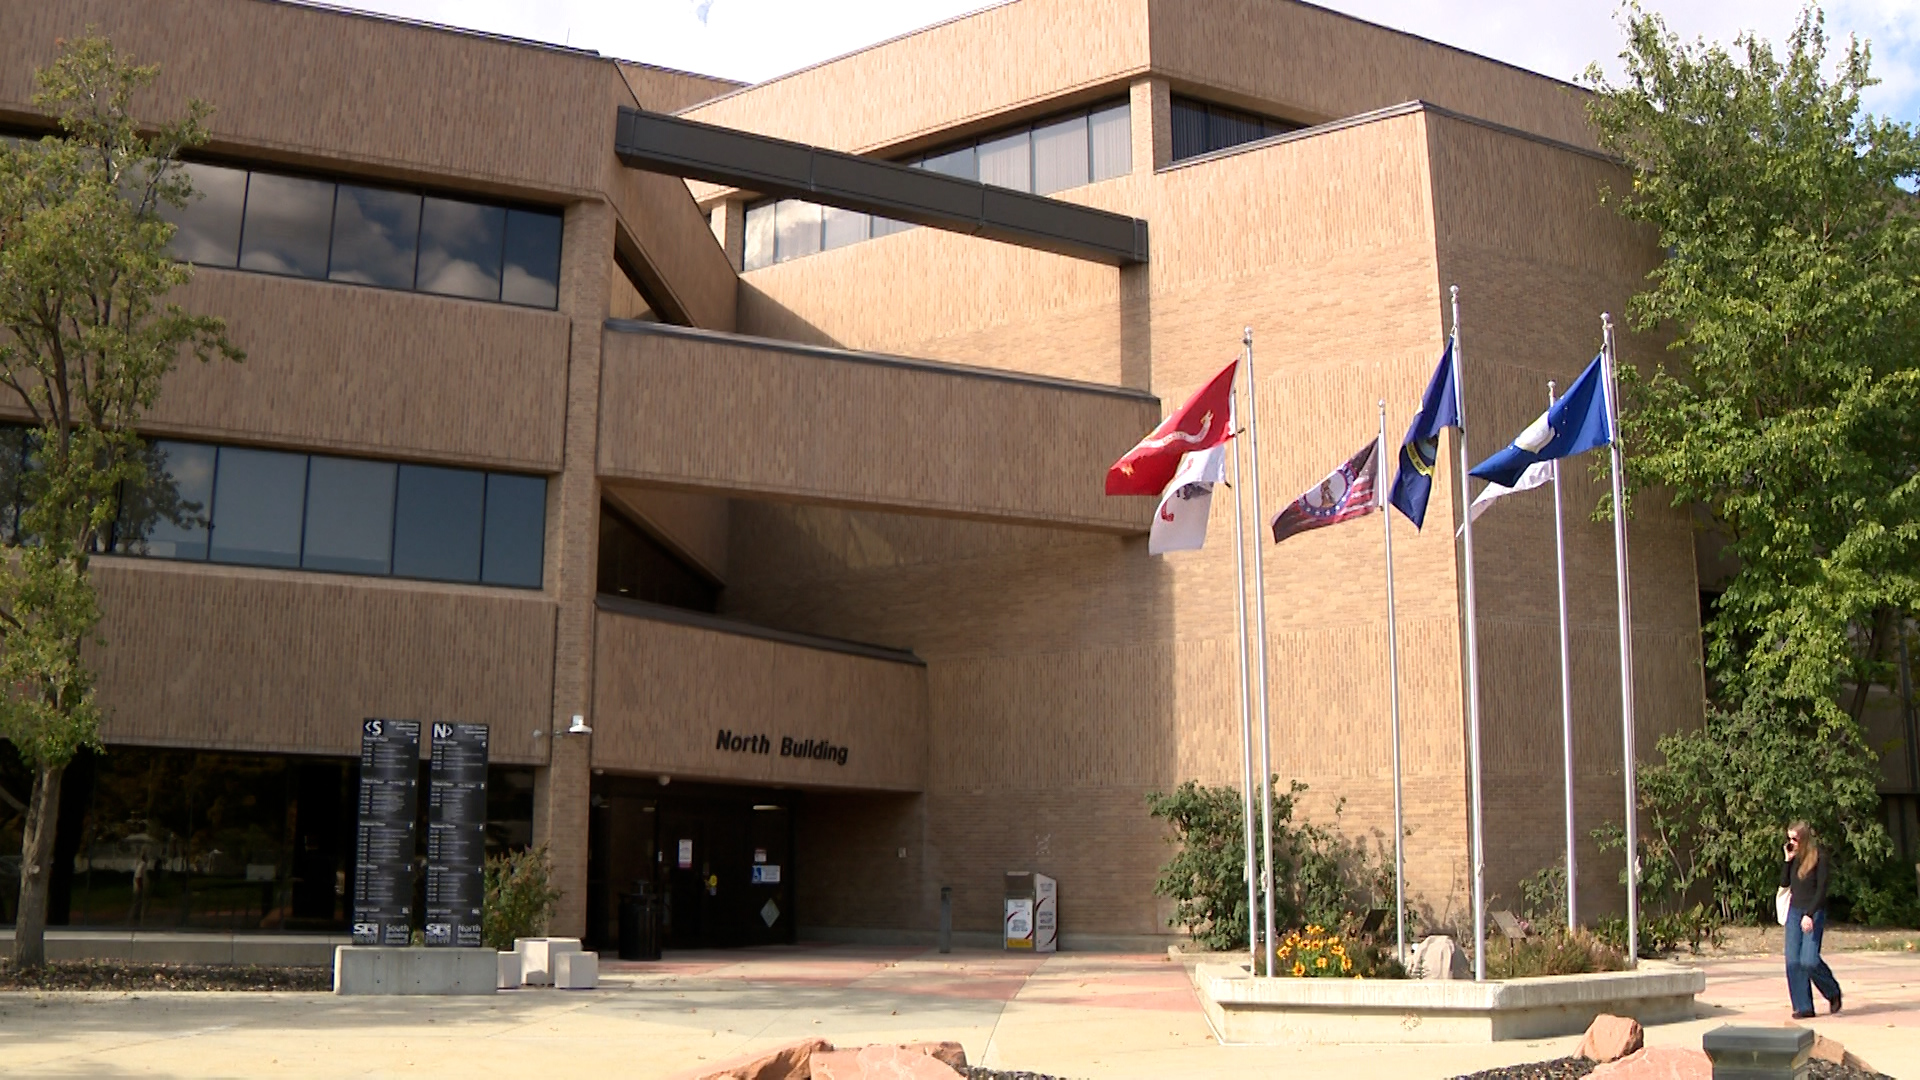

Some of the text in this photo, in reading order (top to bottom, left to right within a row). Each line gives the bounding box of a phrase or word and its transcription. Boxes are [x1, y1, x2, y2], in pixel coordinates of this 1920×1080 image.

[371, 720, 382, 736] S
[433, 723, 446, 738] N
[716, 729, 849, 766] North Building
[385, 923, 410, 932] South
[457, 923, 481, 932] North
